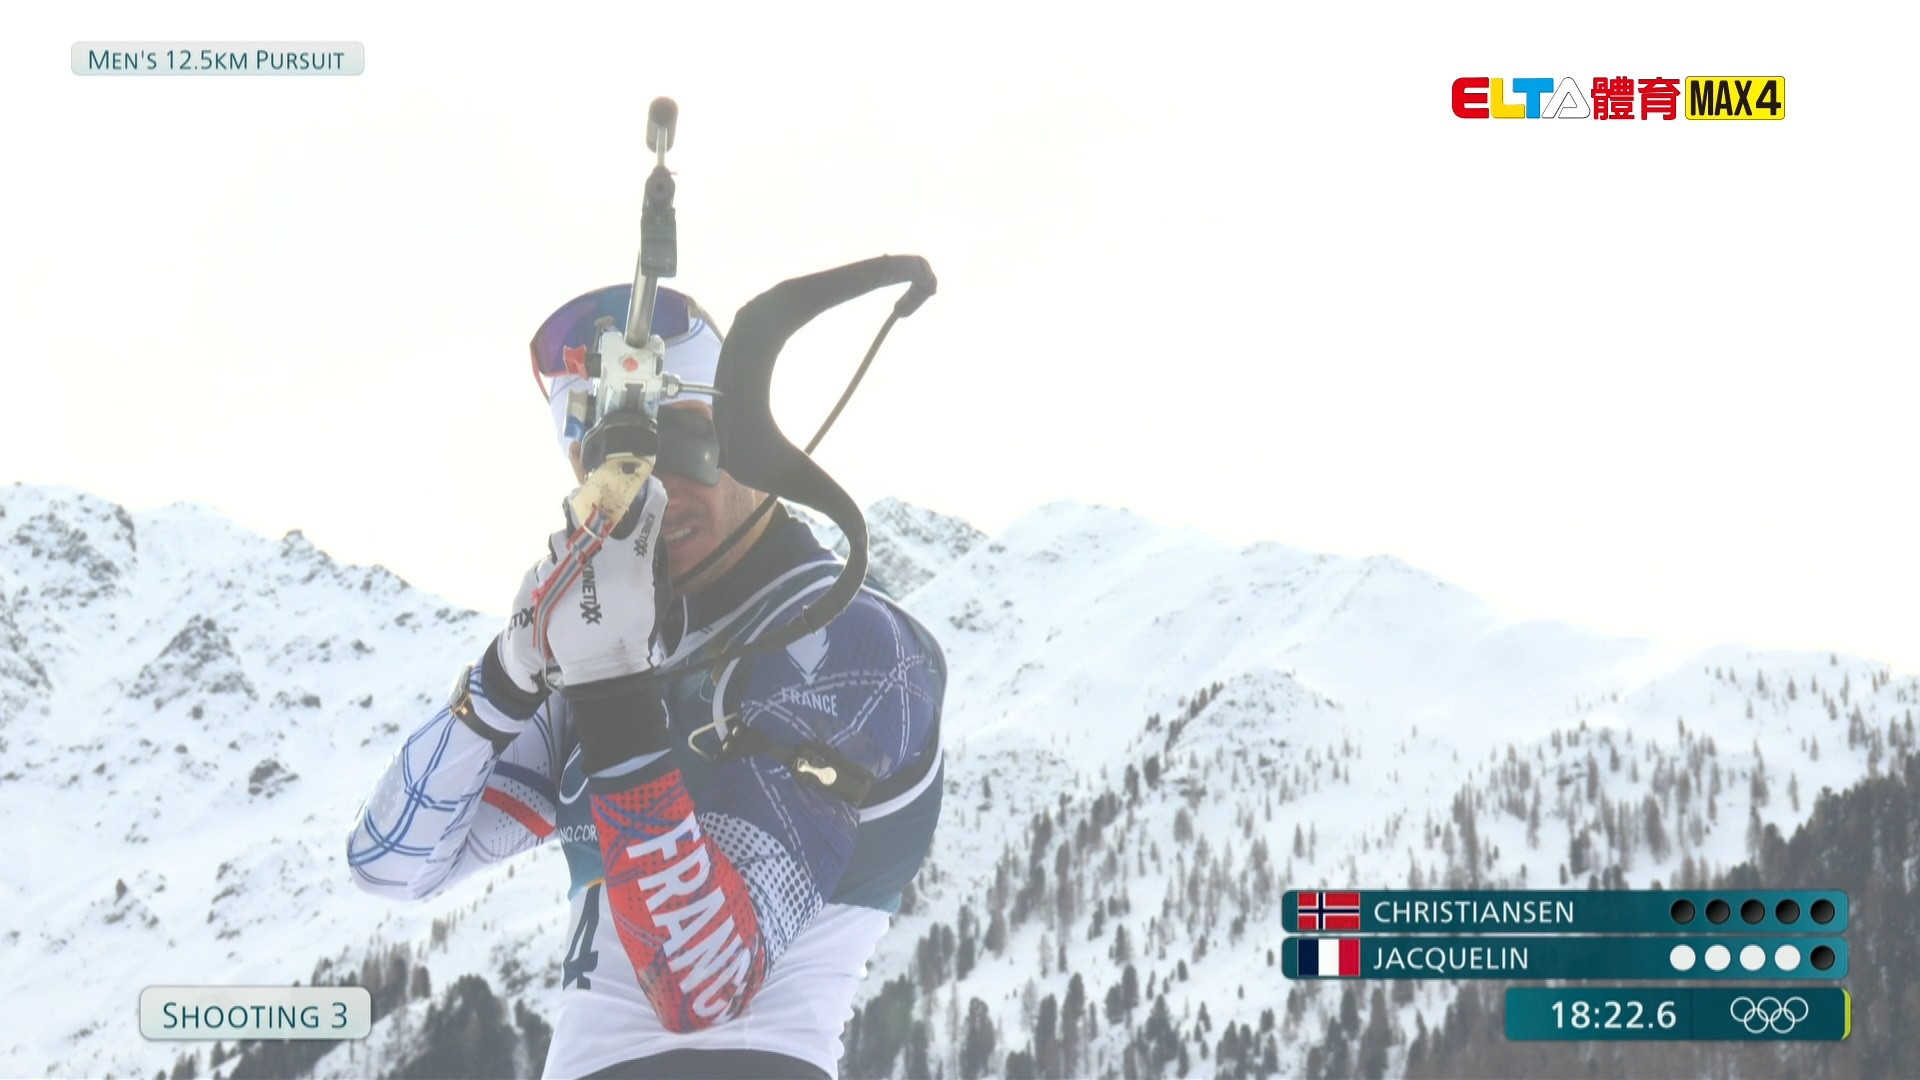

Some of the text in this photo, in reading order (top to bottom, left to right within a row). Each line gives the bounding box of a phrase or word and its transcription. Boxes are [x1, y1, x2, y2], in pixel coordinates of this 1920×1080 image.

[781, 686, 838, 717] FRANCE
[562, 882, 601, 990] 4
[626, 810, 751, 1023] FRANC
